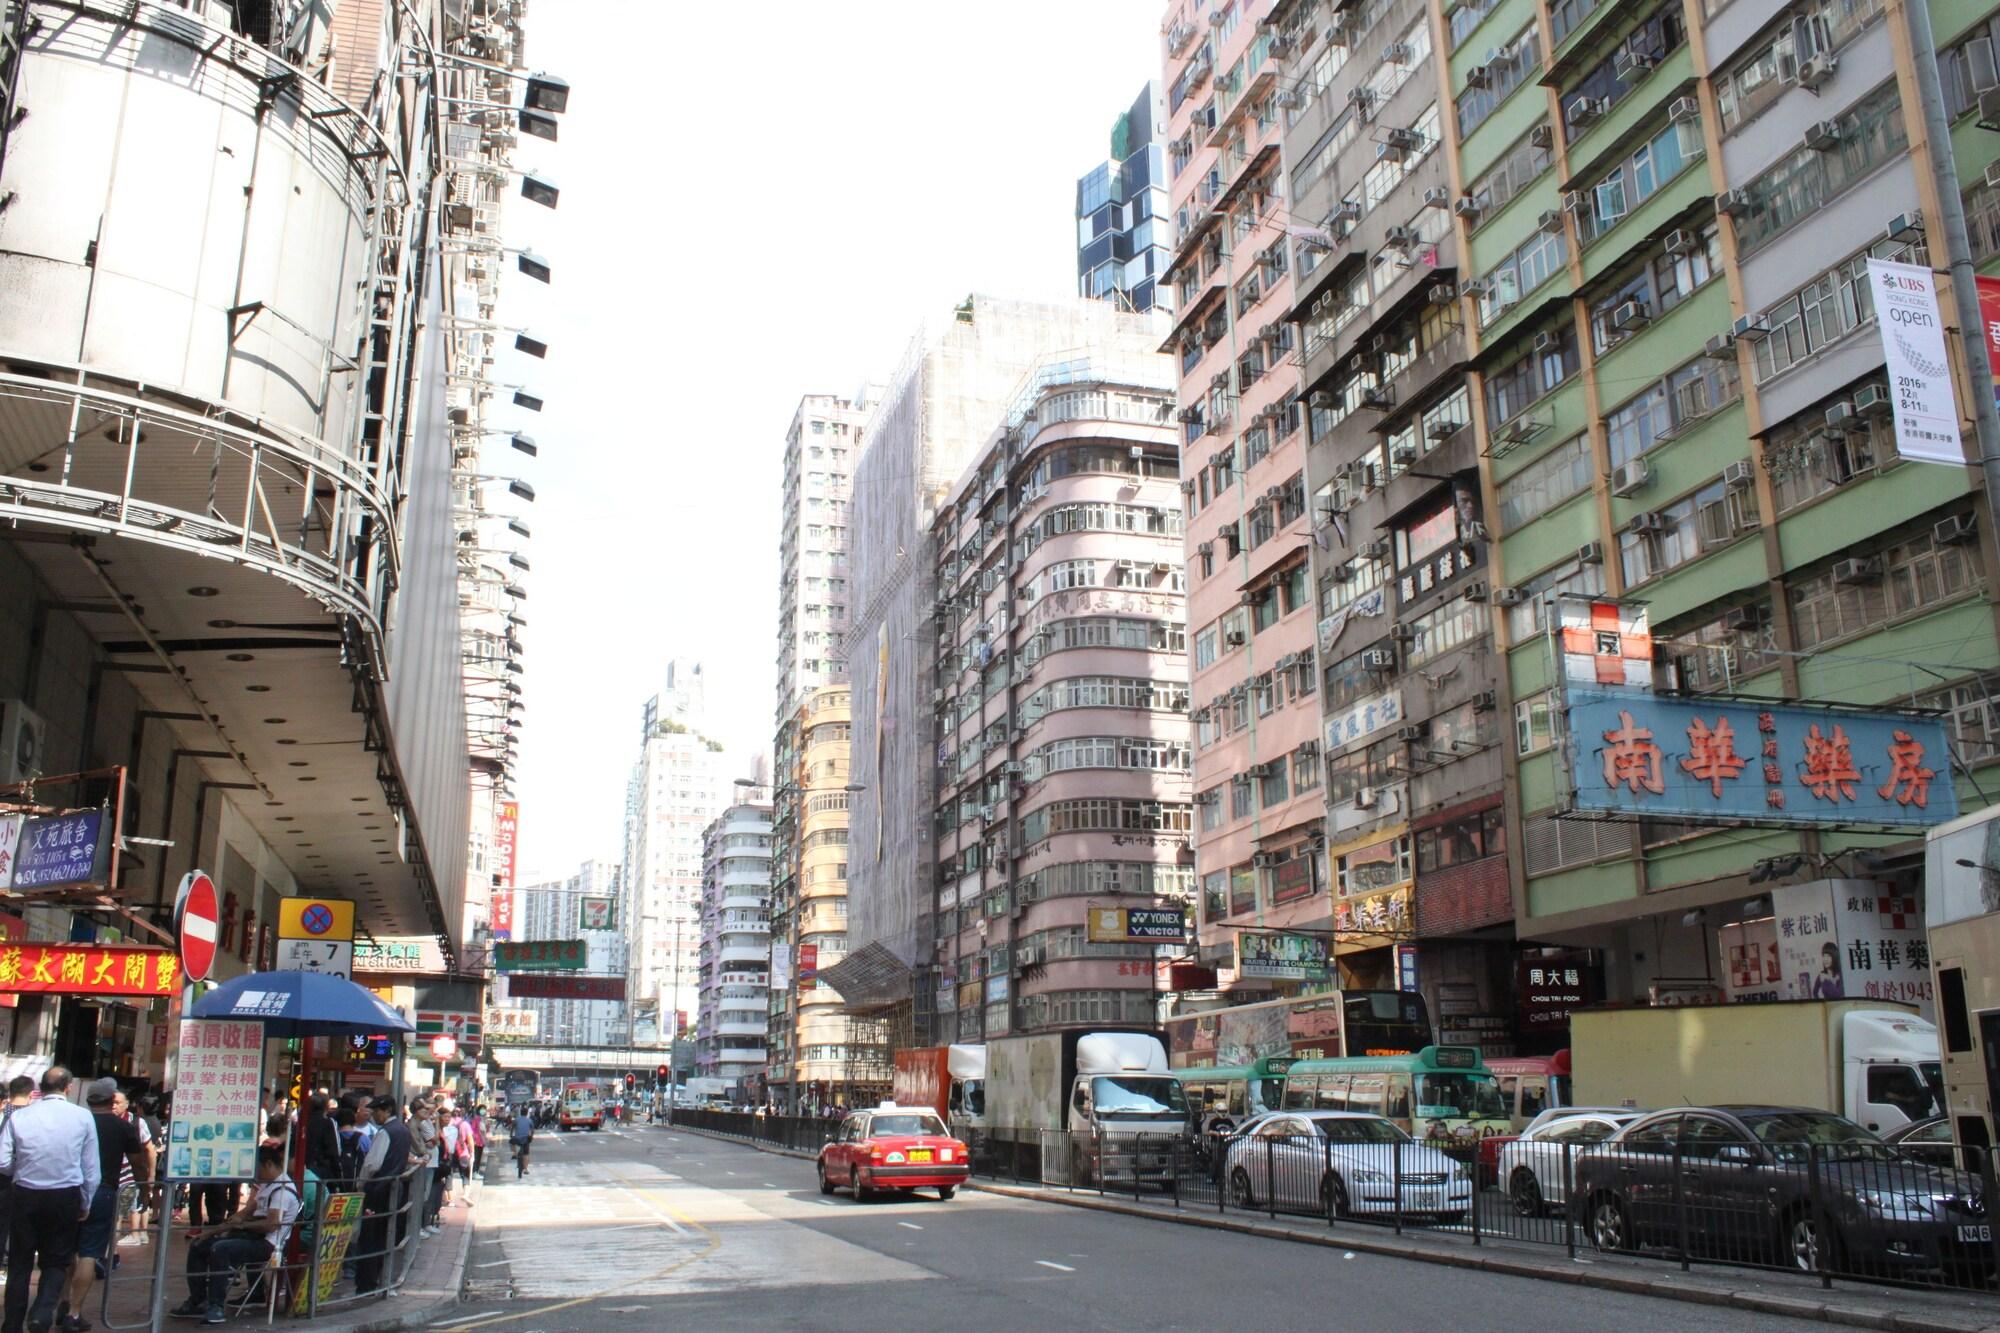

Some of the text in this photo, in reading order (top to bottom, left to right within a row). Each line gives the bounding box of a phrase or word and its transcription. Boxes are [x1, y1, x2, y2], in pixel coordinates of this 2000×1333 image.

[1898, 277, 1925, 292] UBS
[1886, 294, 1906, 303] HONG
[1890, 308, 1933, 327] open
[1847, 897, 1874, 913] 政府
[1150, 912, 1180, 924] YONEX
[1144, 927, 1180, 936] VICTOR
[325, 943, 338, 960] 7
[388, 958, 424, 969] HOTEL
[1530, 969, 1579, 986] 周大福
[181, 1023, 262, 1050] 高價收機
[180, 1053, 258, 1068] 手提電腦
[179, 1071, 258, 1086] 專業相機
